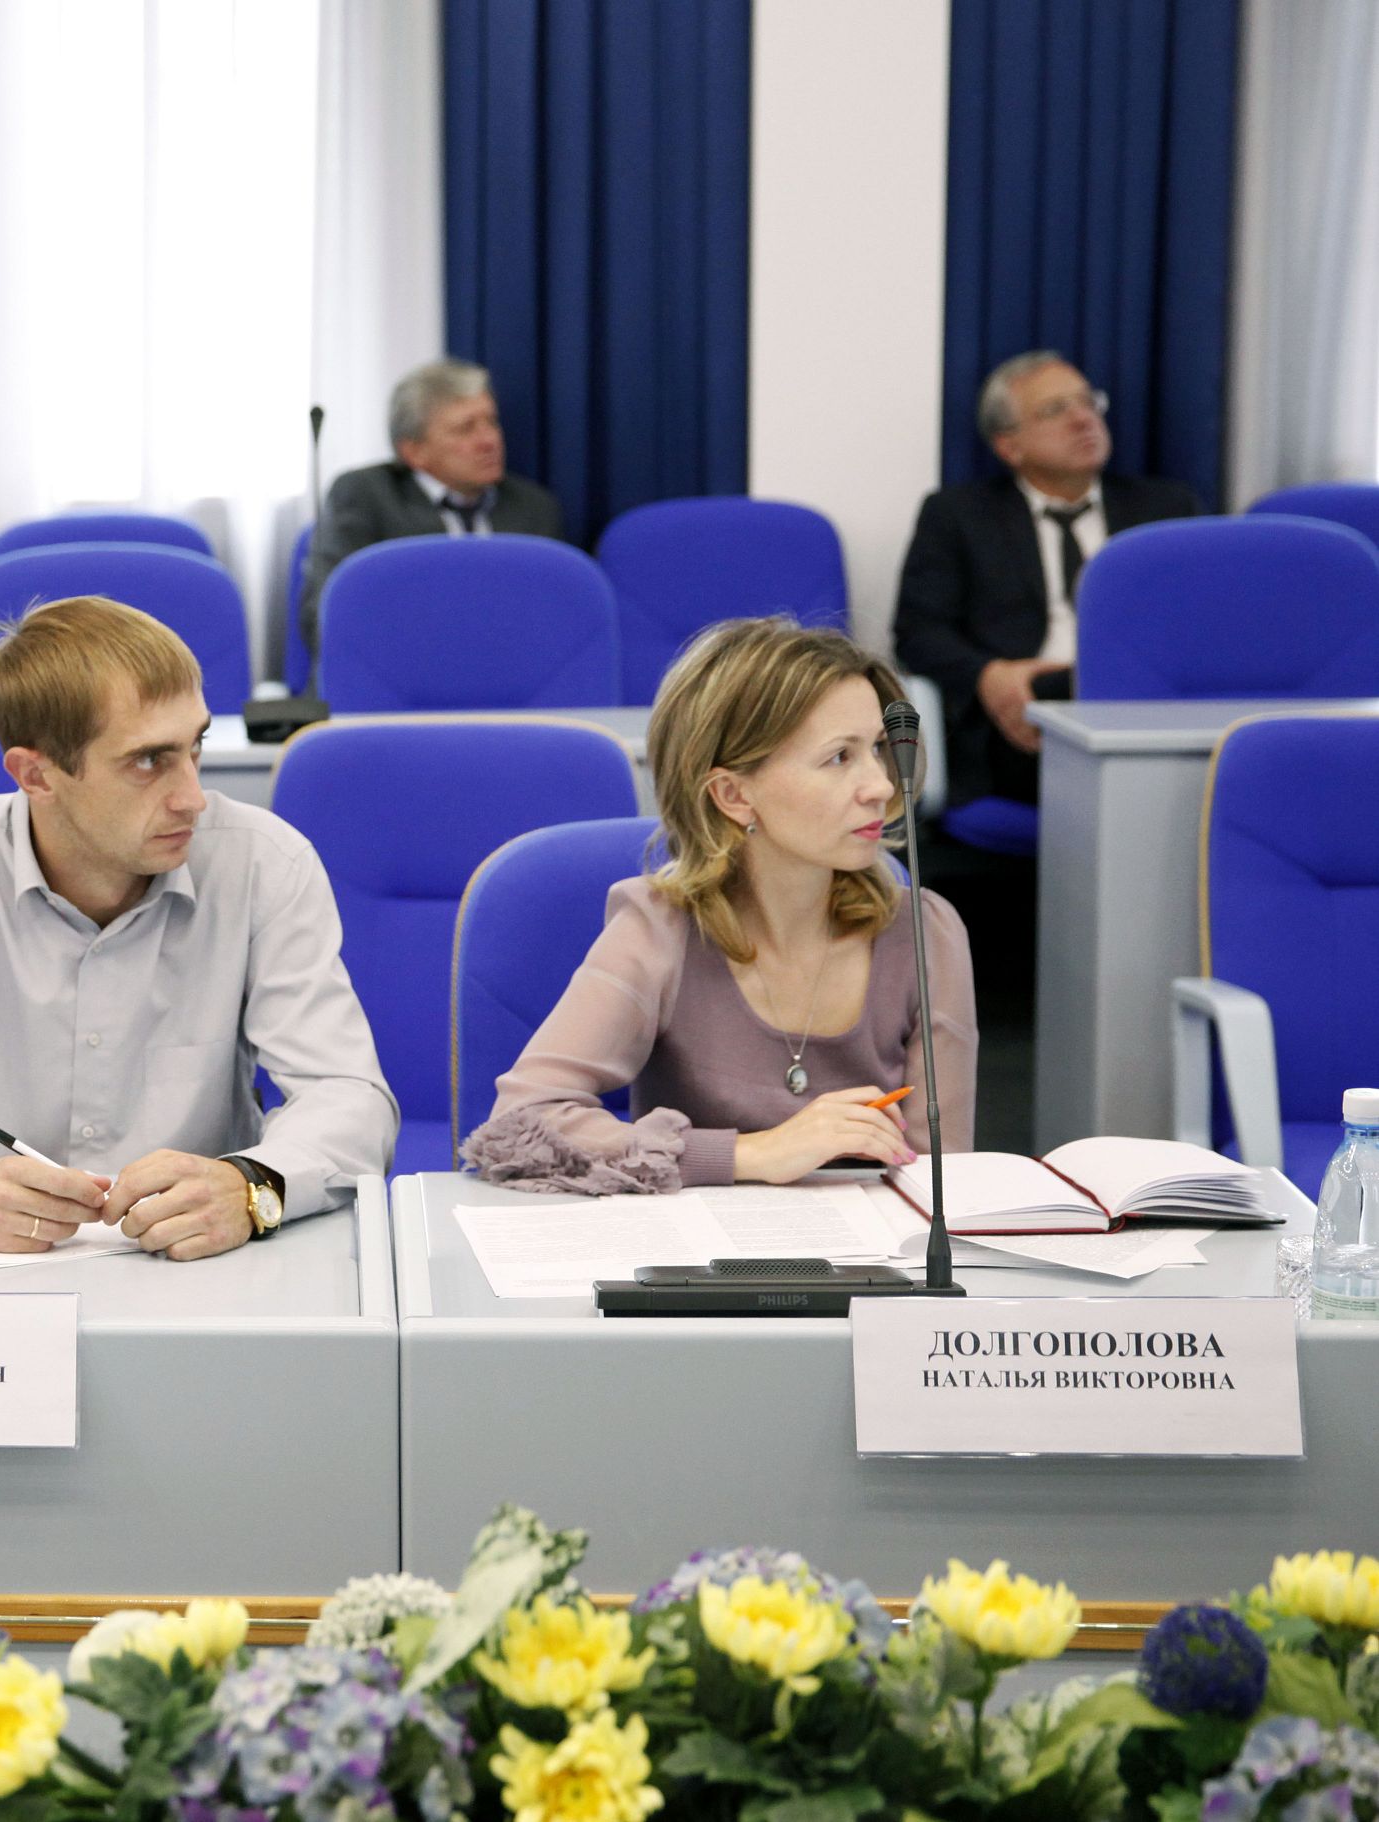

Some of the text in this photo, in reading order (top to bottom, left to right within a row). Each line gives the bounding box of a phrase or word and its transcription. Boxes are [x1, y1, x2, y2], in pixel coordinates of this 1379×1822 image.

[758, 1294, 809, 1306] PHILIPS
[928, 1331, 1225, 1360] ДОЛГОПОЛОВА
[922, 1370, 1236, 1390] НАТАЛЬЯ ВИКТОРОВНА
